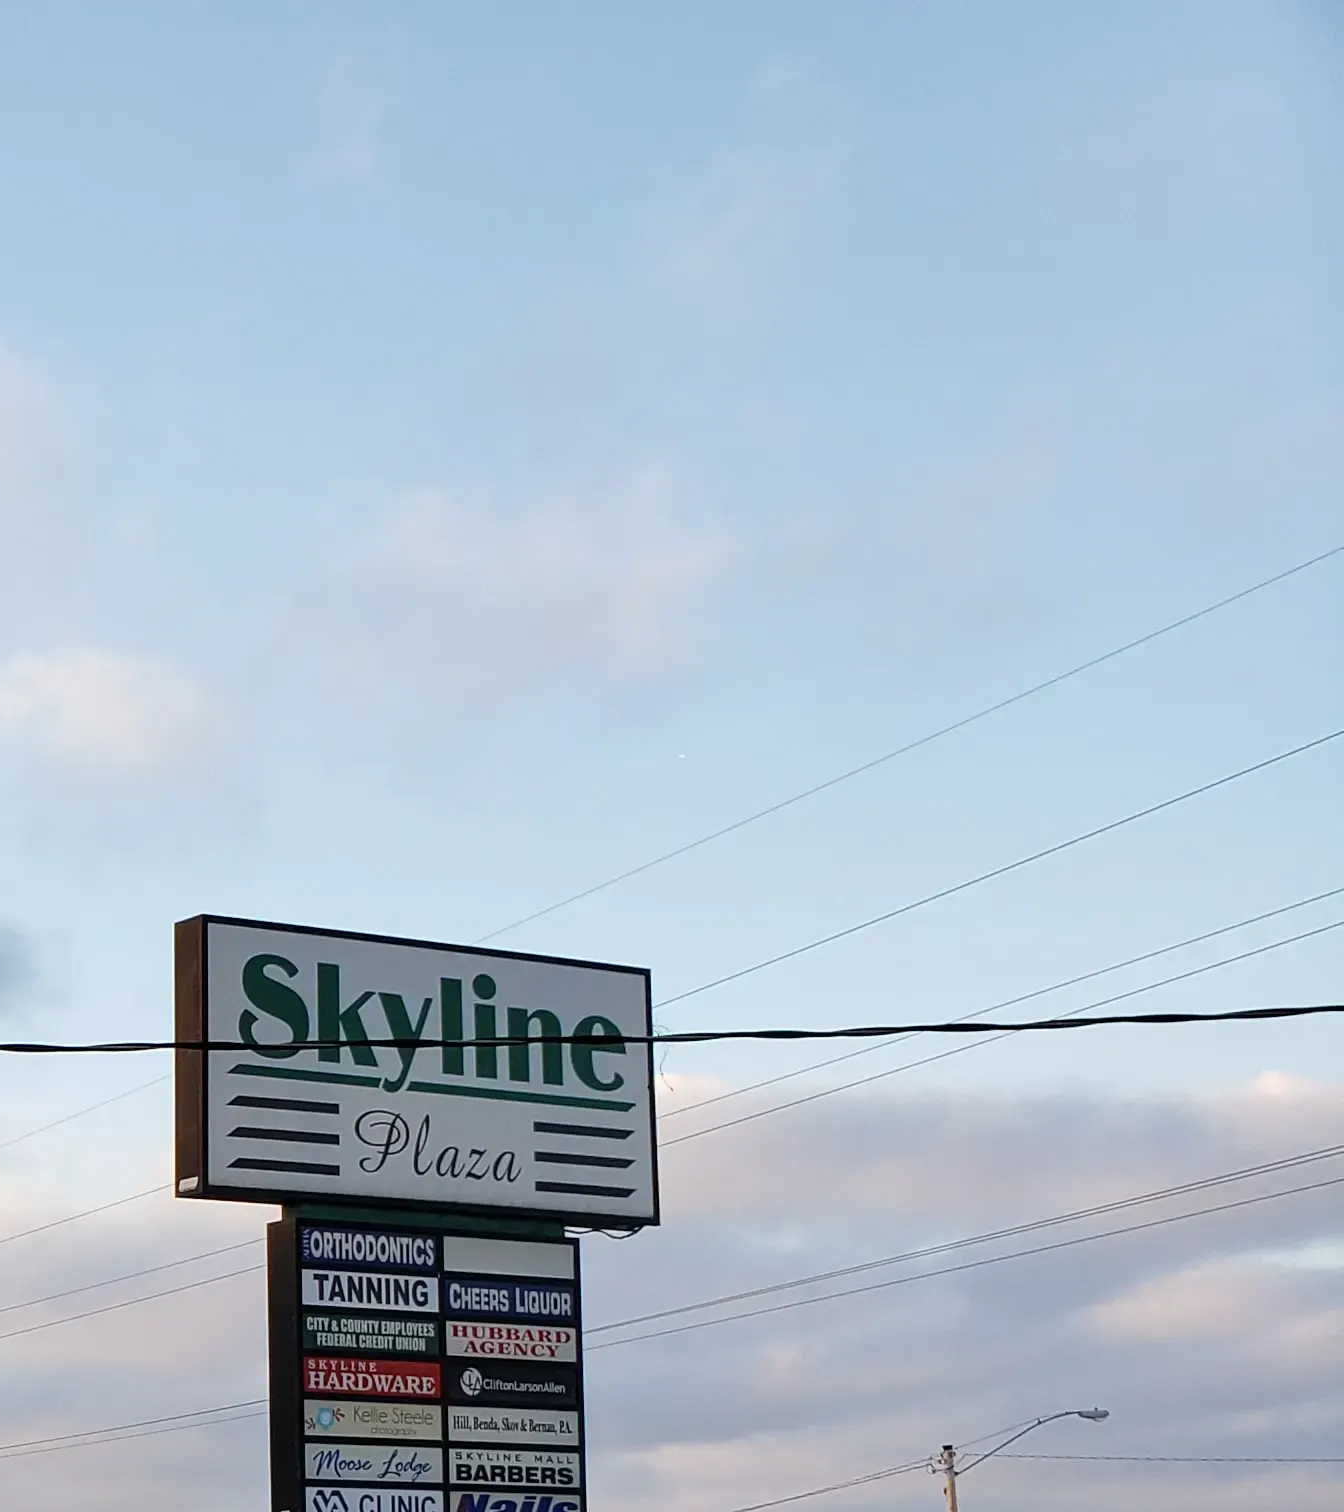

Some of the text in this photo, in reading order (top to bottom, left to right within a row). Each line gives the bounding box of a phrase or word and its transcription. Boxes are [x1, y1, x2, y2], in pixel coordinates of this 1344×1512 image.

[238, 953, 627, 1093] Skyline
[355, 1110, 524, 1183] Plaza
[310, 1230, 435, 1267] ORTHODONTICS
[313, 1273, 430, 1308] TANNING
[449, 1282, 572, 1317] CHEERS LIQUOR
[306, 1316, 435, 1337] CITY & COUNTY EMPLOYEES
[451, 1324, 571, 1344] HUBBARD
[317, 1332, 426, 1351] FEDERAL CREDIT UNION
[464, 1339, 561, 1358] AGENCY
[308, 1358, 377, 1373] SKYLINE
[308, 1371, 436, 1396] HARDWARE
[483, 1378, 566, 1395] CliftonLarsonAllen
[353, 1405, 433, 1426] Kellie Steele
[453, 1415, 472, 1432] Hill,
[474, 1416, 500, 1434] Benda,
[519, 1418, 528, 1431] &
[313, 1449, 432, 1481] Moose Lodge
[454, 1451, 574, 1465] SKYLINE MALL
[456, 1464, 574, 1485] BARBERS
